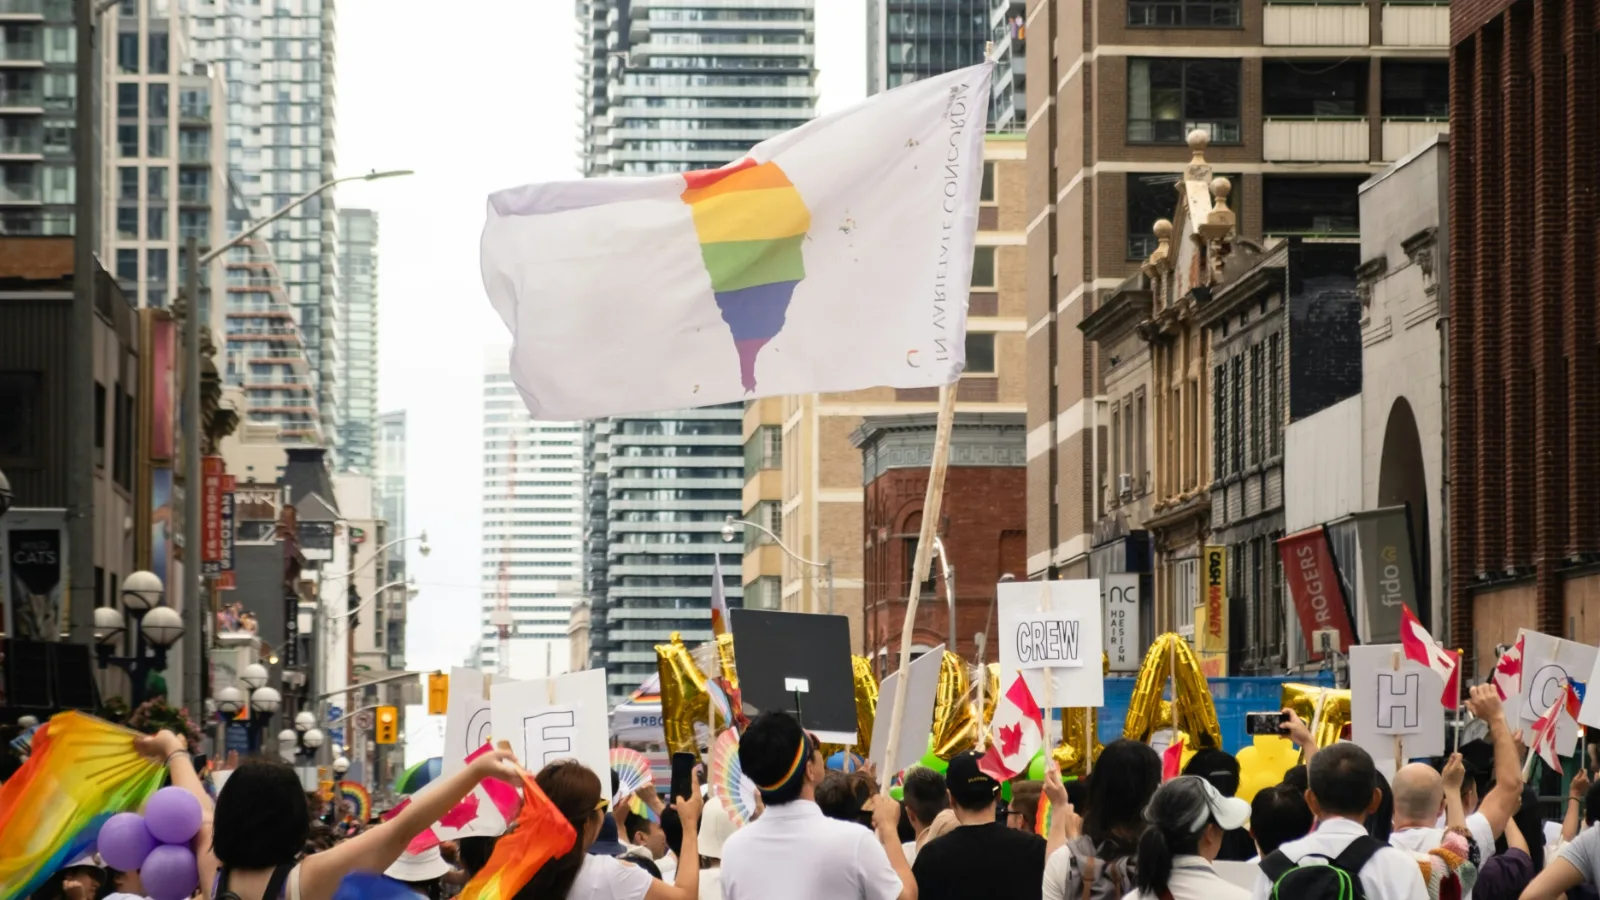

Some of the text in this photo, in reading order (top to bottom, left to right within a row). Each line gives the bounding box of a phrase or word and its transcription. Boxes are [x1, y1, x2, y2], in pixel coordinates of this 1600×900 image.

[220, 495, 232, 570] 24 HOURS
[13, 551, 57, 565] CATS
[1110, 586, 1135, 603] nc
[1209, 551, 1221, 638] CASH MONEY
[1296, 545, 1331, 622] ROGERS
[1379, 564, 1402, 608] fido
[1016, 620, 1079, 663] CREW
[1110, 610, 1118, 645] HAIR
[1377, 673, 1419, 728] H
